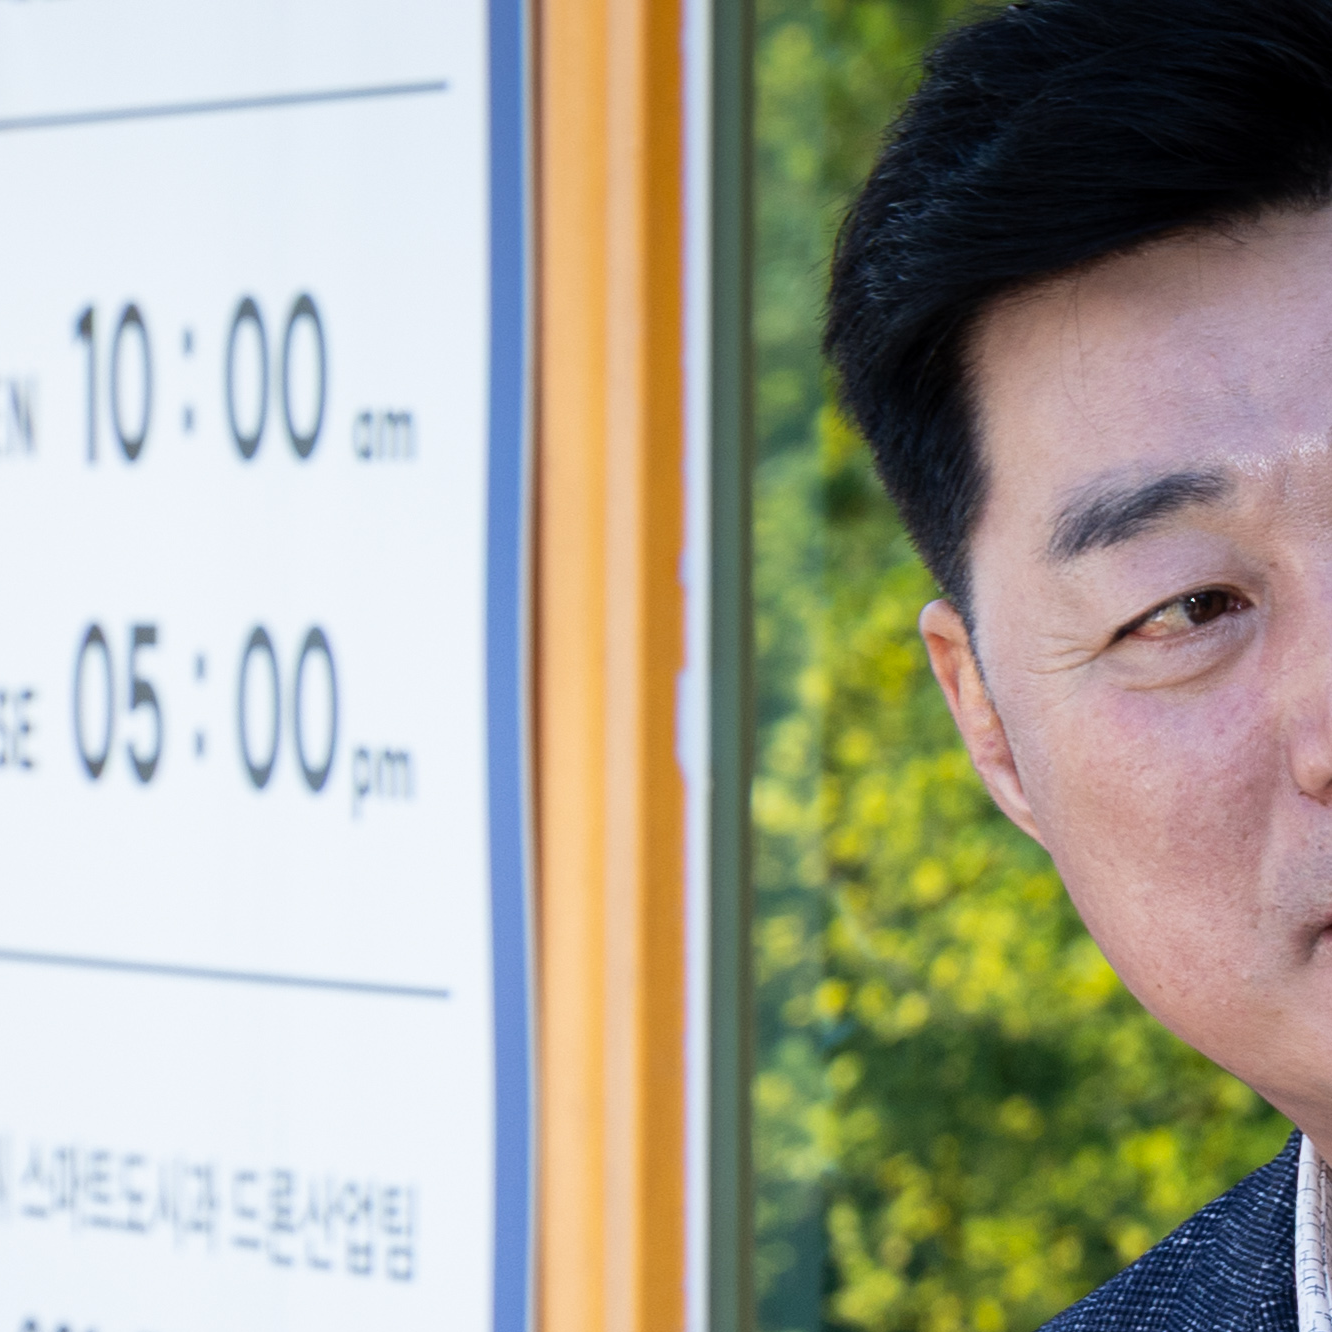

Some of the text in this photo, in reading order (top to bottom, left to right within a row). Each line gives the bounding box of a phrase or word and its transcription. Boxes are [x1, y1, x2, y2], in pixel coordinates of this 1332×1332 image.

[352, 408, 417, 463] am
[353, 745, 415, 821] pm
[233, 1165, 416, 1284] 드론산업팀
